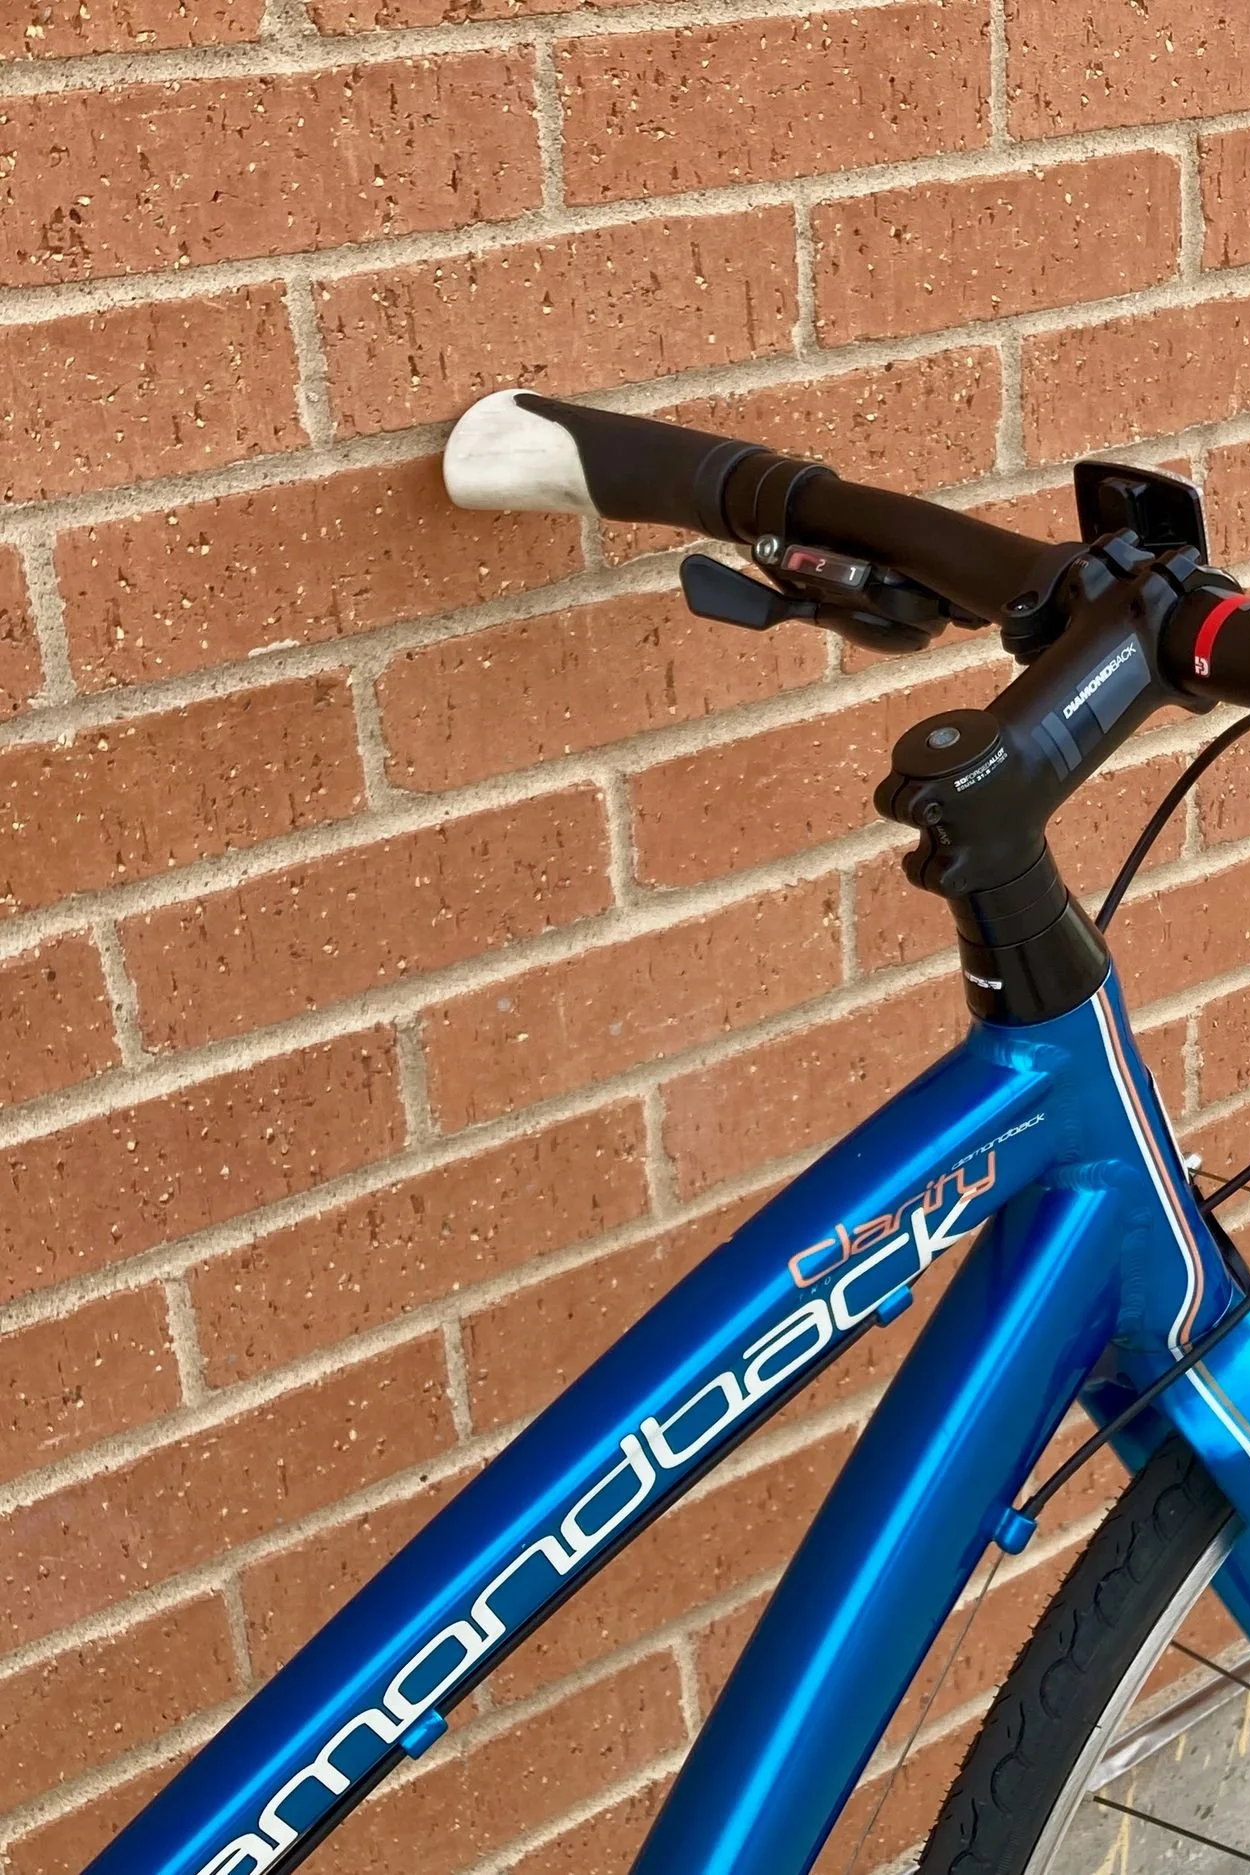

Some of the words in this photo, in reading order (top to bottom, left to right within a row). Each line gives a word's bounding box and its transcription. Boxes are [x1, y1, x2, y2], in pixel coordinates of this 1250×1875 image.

[816, 558, 827, 573] 2
[848, 566, 857, 581] 1
[1063, 642, 1137, 720] DIAMONDBACK
[951, 1112, 1045, 1171] diamondback
[788, 1151, 996, 1288] clarity
